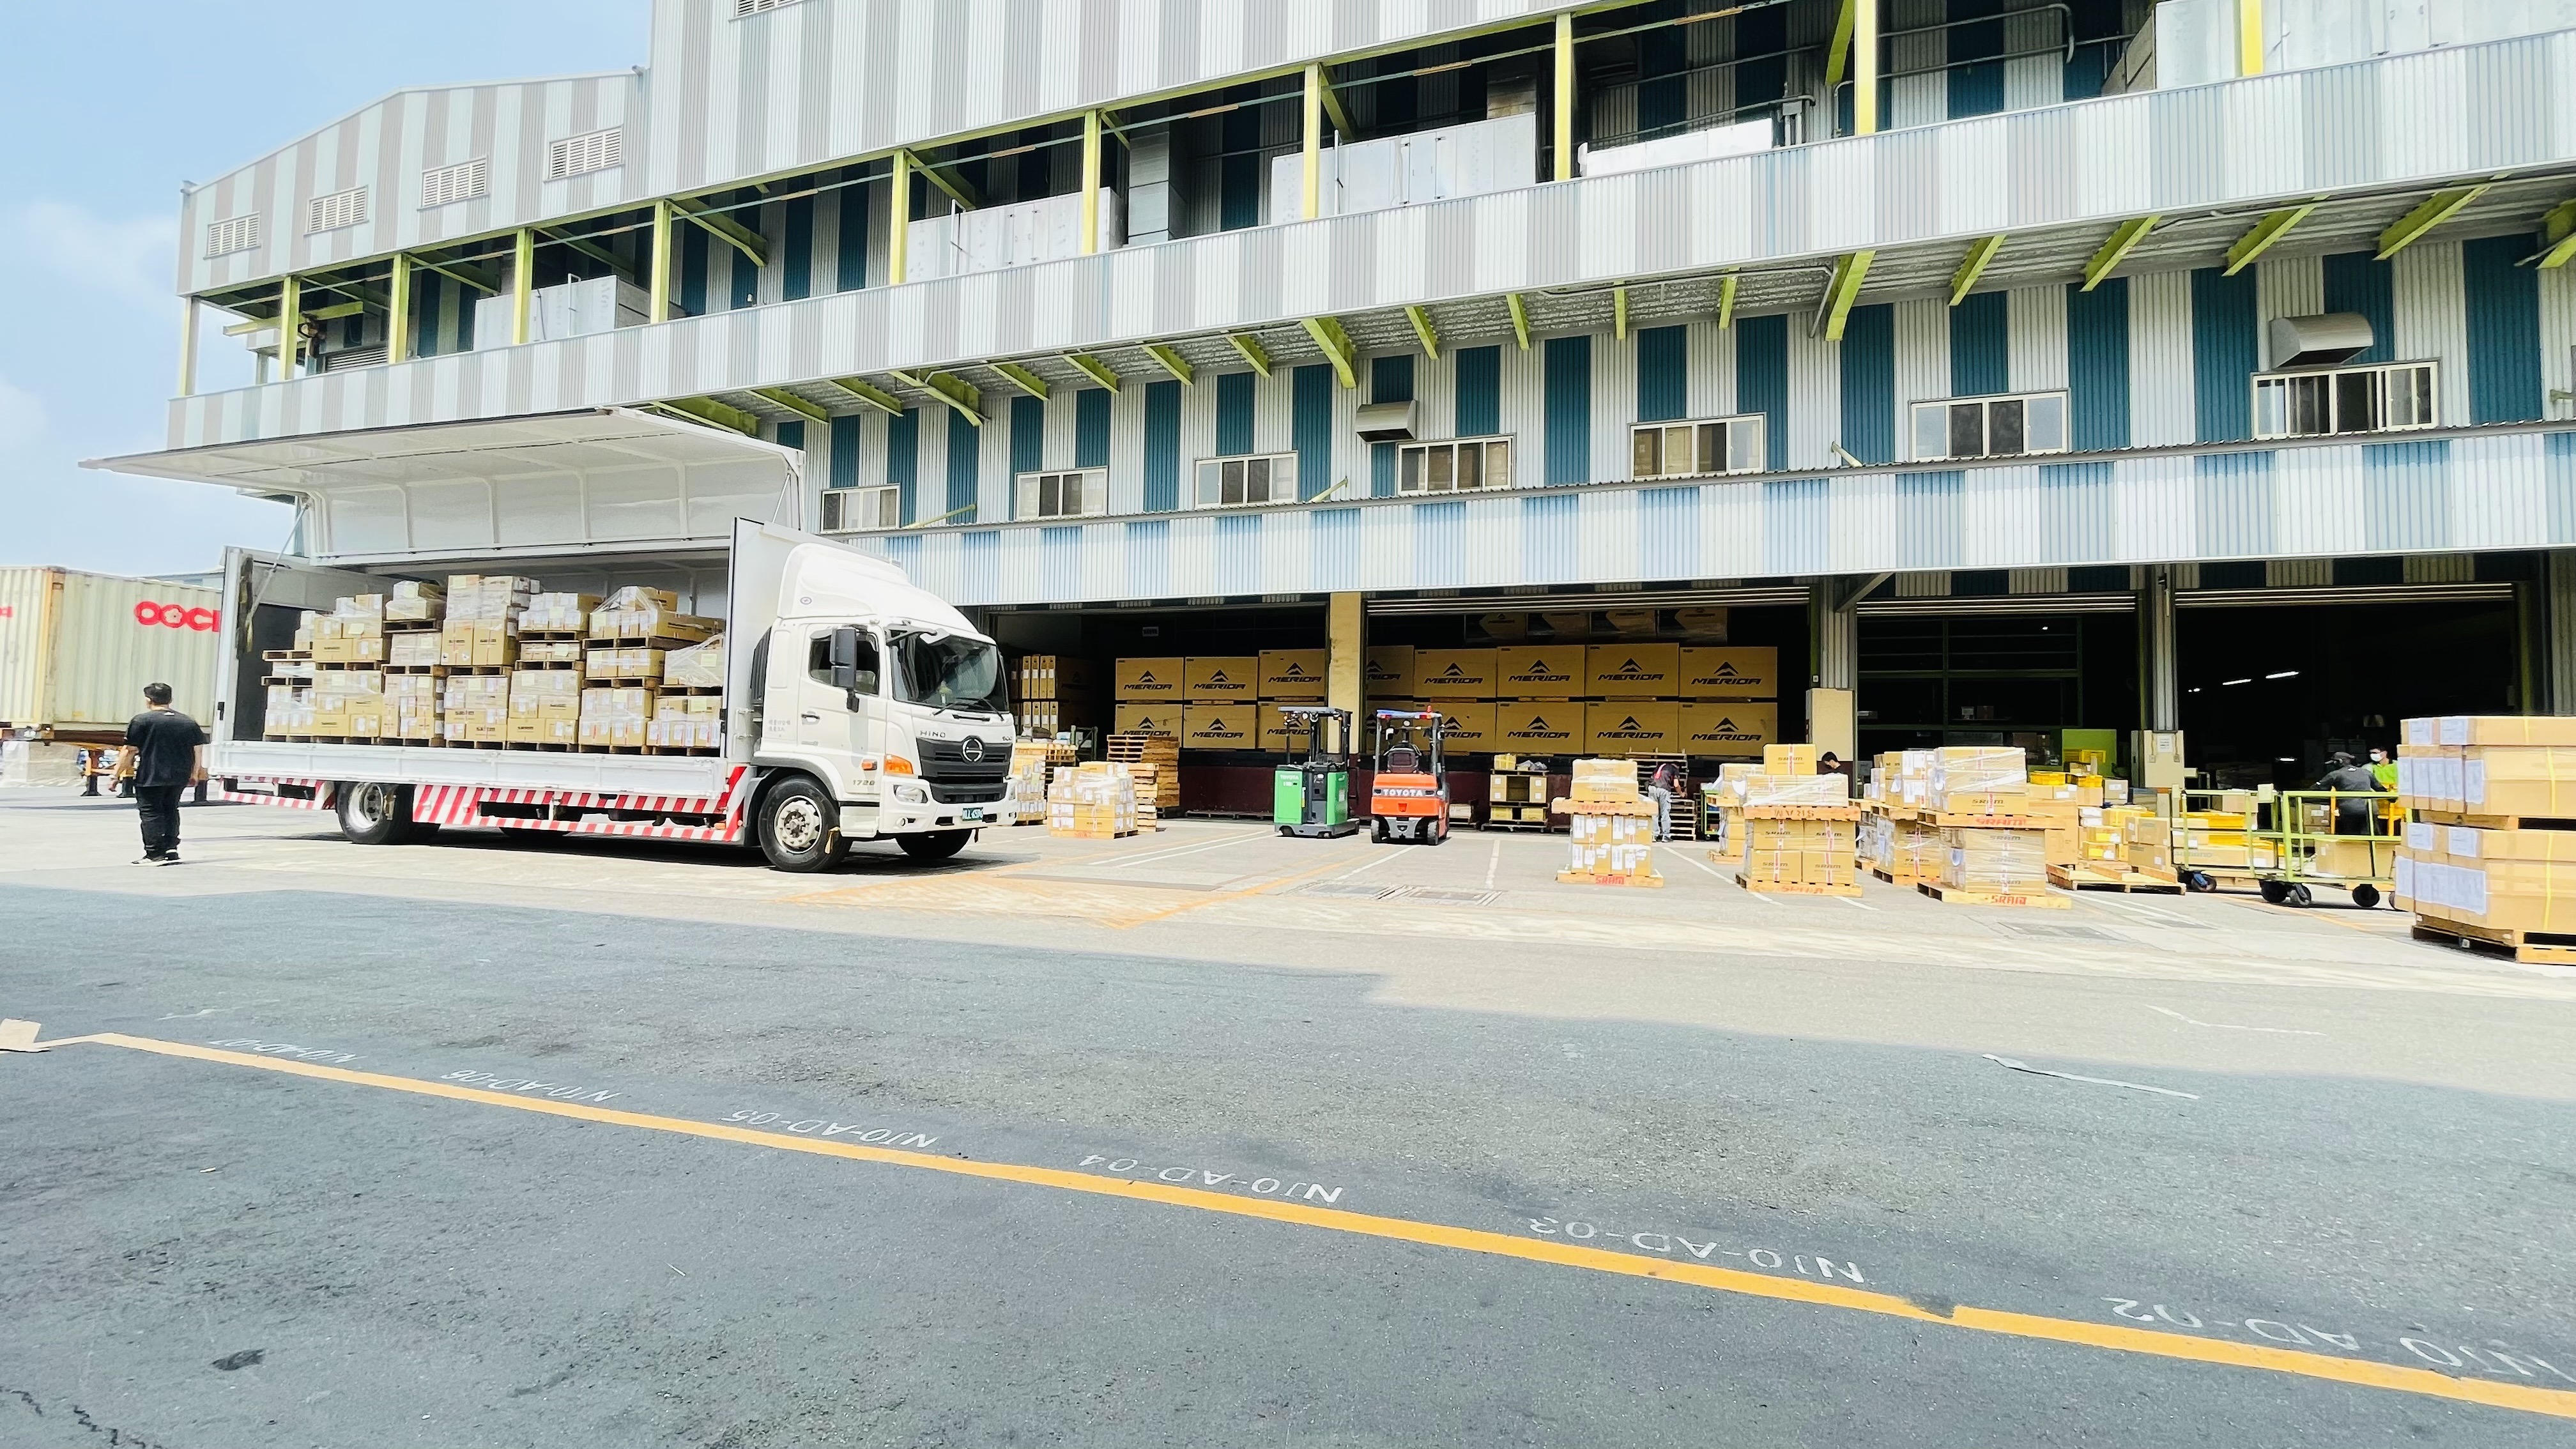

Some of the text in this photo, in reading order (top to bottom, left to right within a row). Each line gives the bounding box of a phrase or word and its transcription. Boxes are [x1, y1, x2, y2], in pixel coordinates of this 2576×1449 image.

[1506, 731, 1570, 739] MERIDA
[1597, 731, 1664, 739] MERIDA
[1690, 733, 1762, 742] MERIDA
[1383, 788, 1423, 797] TOYOTA
[1595, 875, 1625, 885] SRAM
[1991, 895, 2027, 905] SRAM
